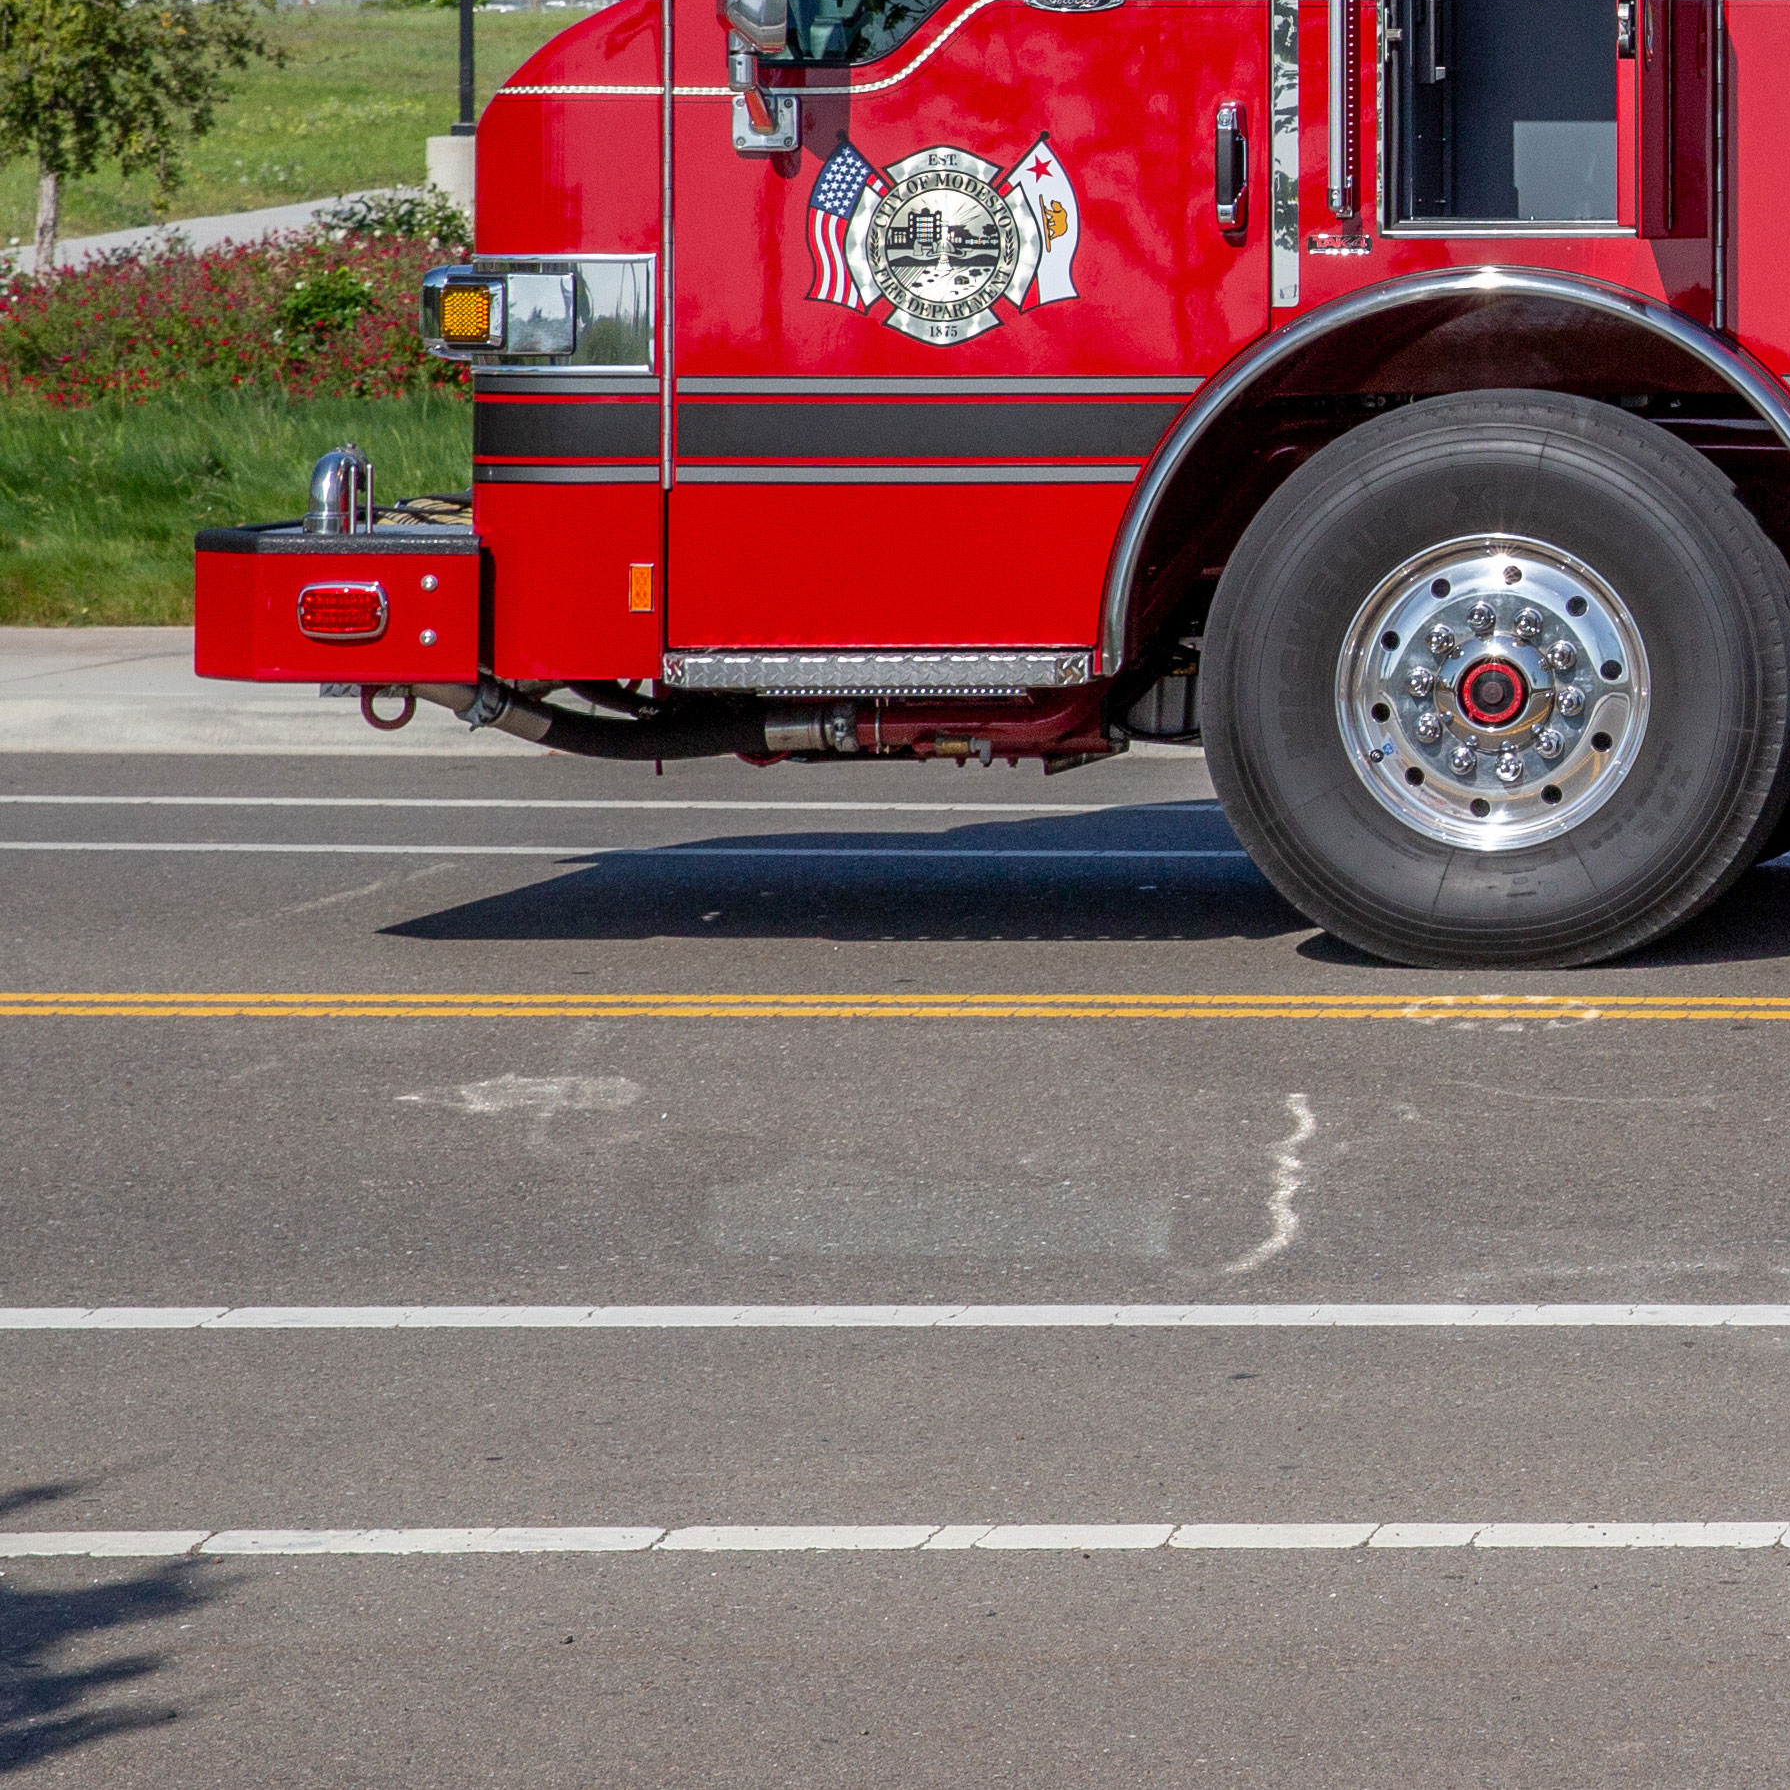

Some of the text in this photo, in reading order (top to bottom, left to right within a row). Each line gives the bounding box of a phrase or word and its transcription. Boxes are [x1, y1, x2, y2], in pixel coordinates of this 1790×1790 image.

[928, 153, 958, 167] EST.
[874, 172, 1014, 230] CITY OF MODESTO
[873, 266, 1011, 319] FIRE DEPARTMENT
[929, 324, 958, 338] 1875
